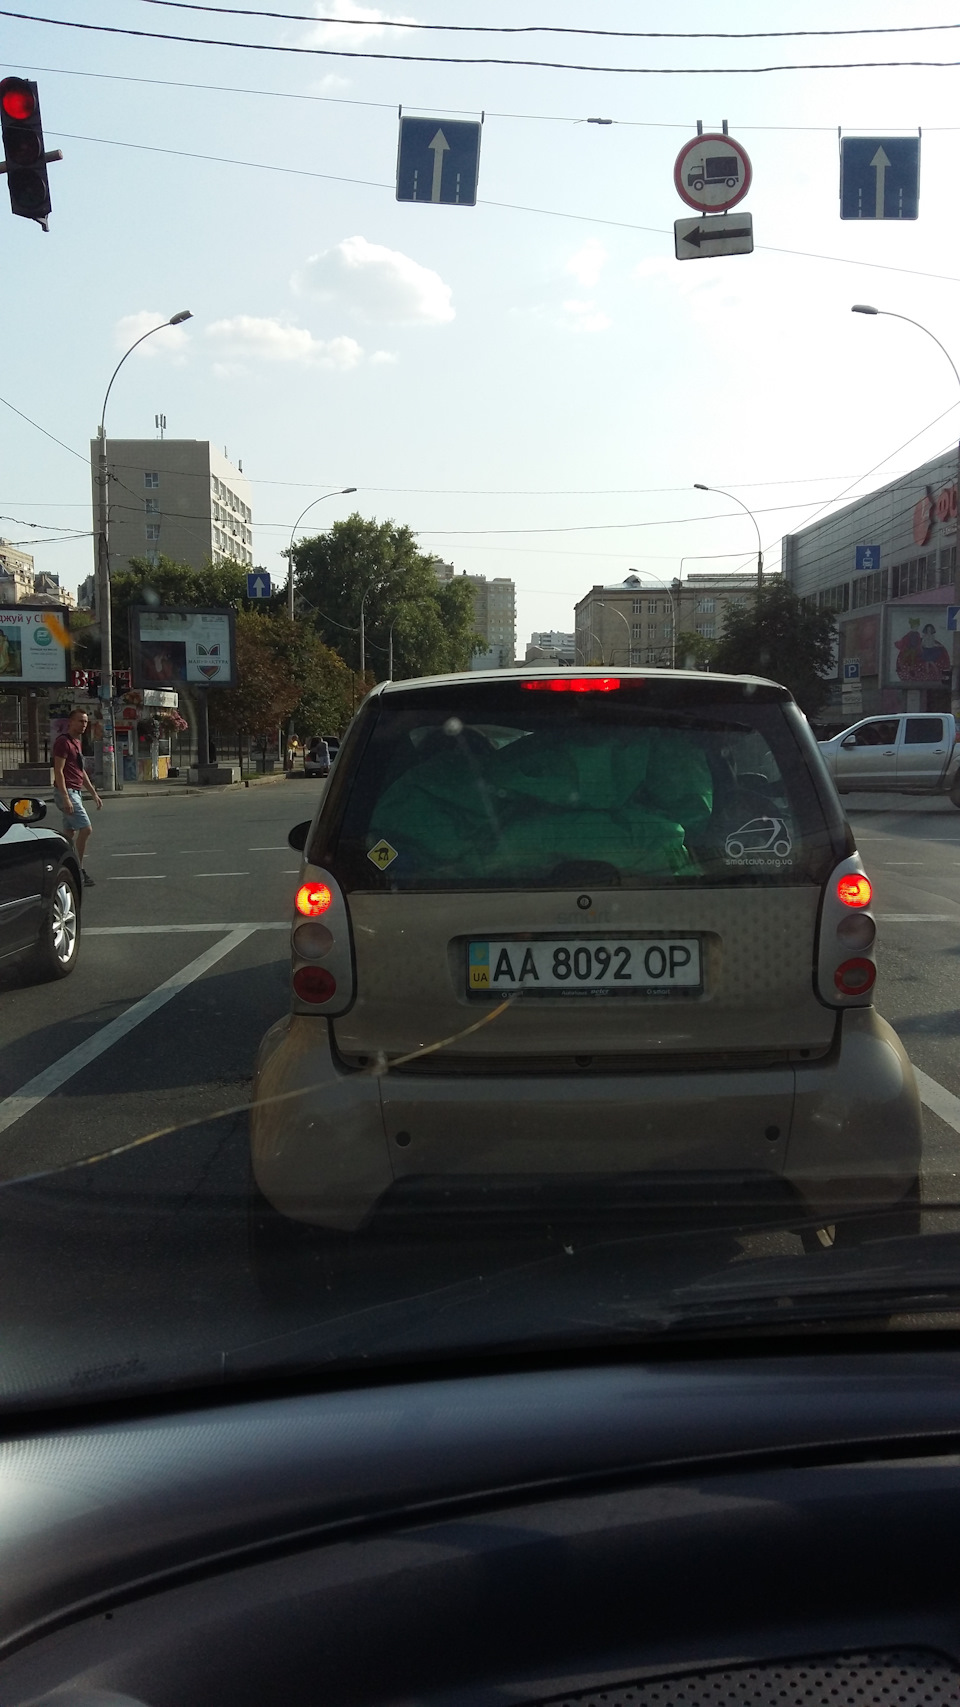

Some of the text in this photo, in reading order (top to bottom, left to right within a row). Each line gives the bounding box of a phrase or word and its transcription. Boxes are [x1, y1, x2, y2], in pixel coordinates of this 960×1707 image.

[725, 858, 793, 868] smartclub.org.ua
[493, 945, 691, 982] AA 8092 OP
[473, 973, 488, 982] UA
